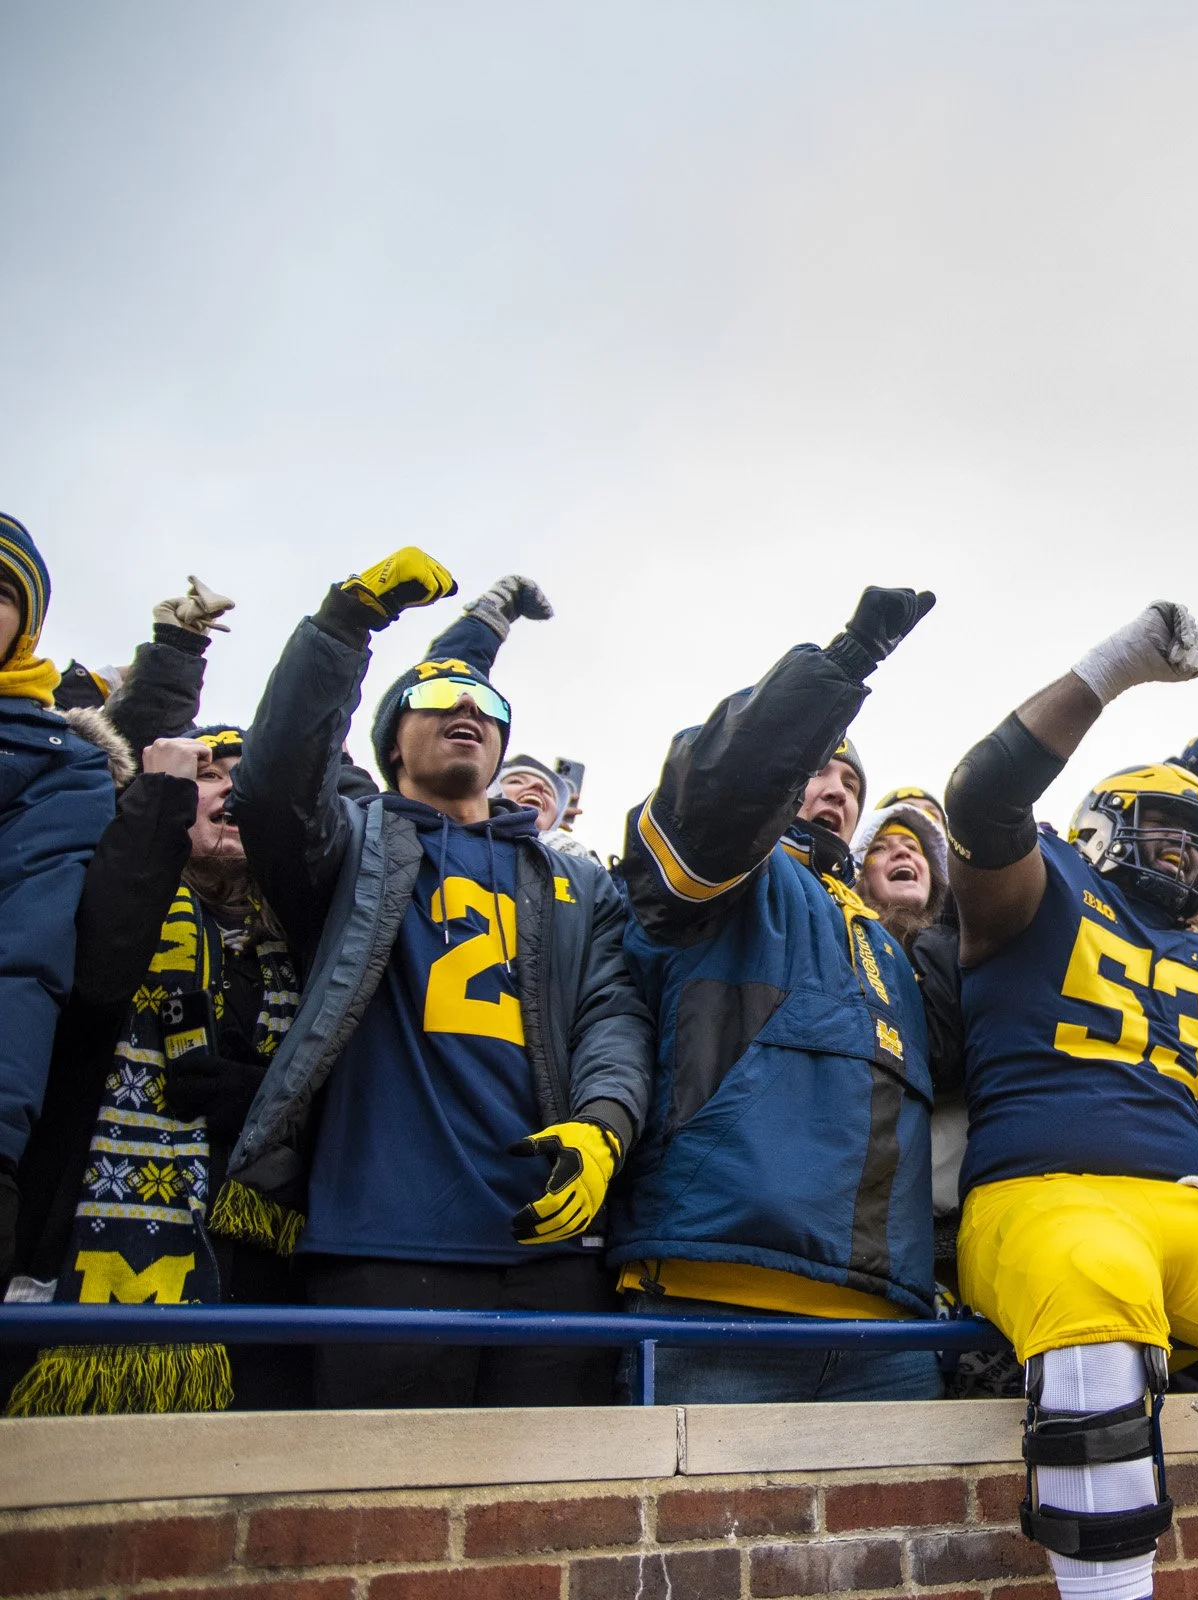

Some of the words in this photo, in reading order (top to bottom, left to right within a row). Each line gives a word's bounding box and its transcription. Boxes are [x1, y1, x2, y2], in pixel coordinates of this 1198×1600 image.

[415, 658, 472, 680] M
[423, 876, 526, 1047] 2
[74, 1250, 196, 1304] M
